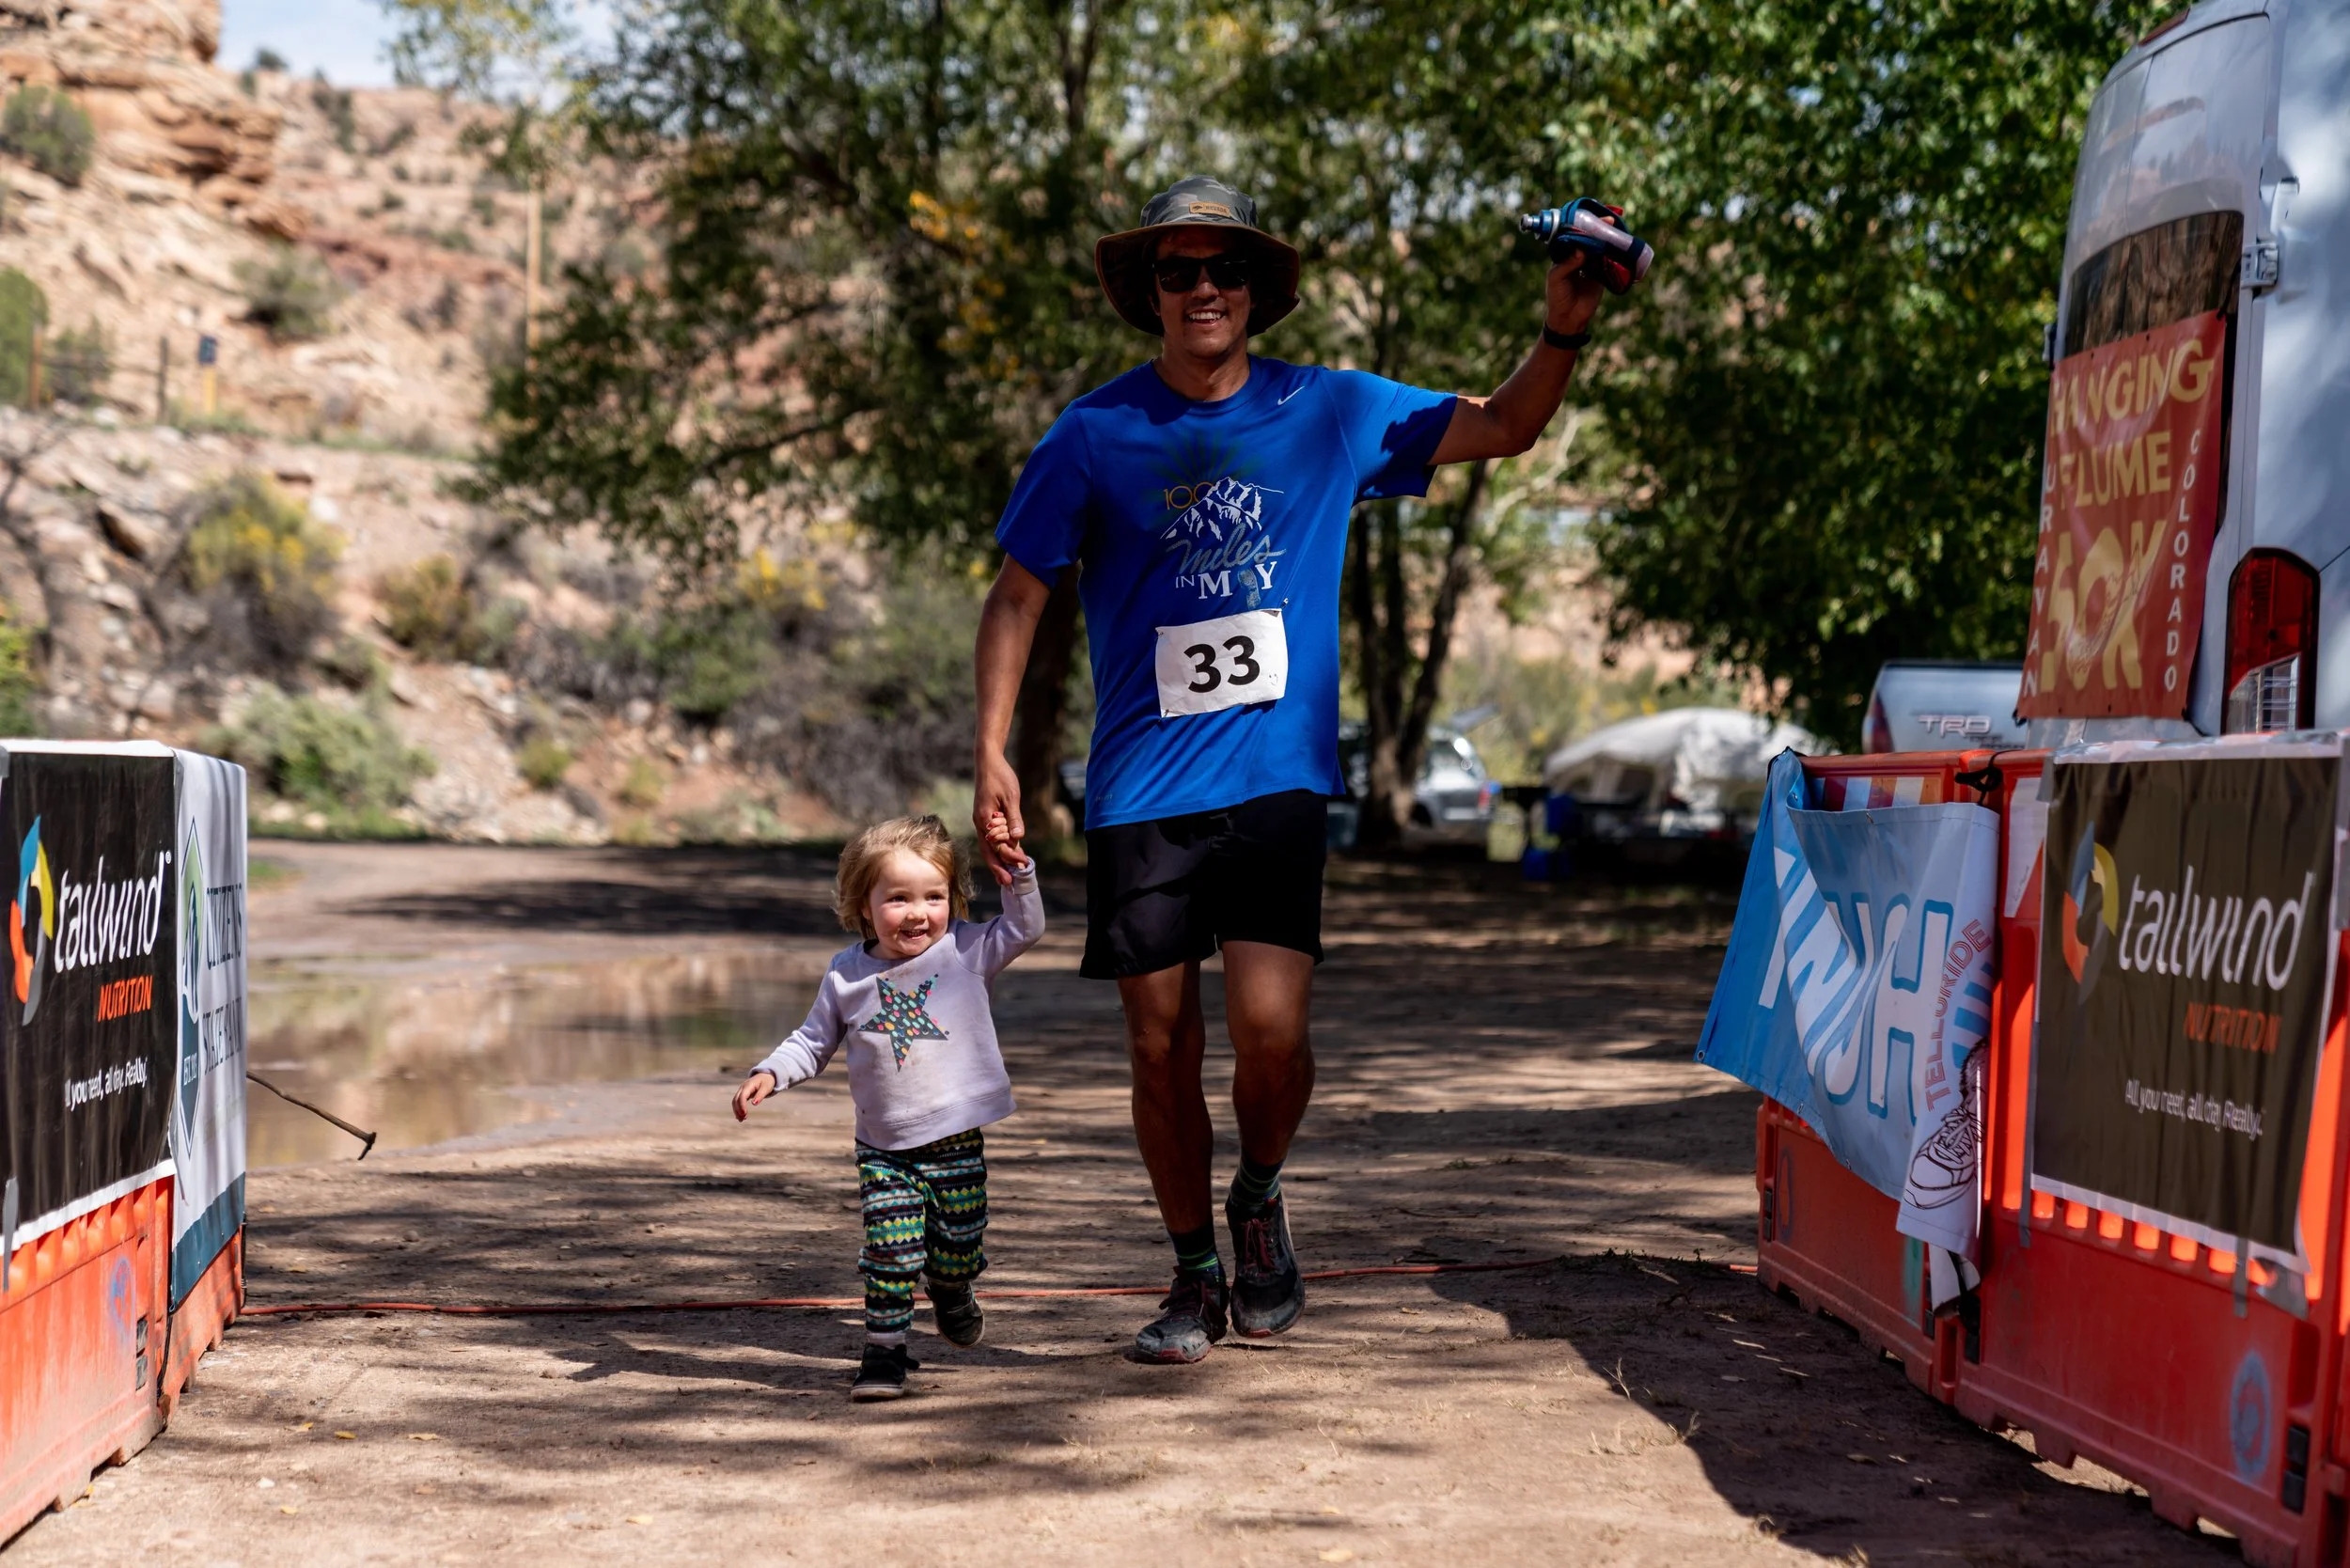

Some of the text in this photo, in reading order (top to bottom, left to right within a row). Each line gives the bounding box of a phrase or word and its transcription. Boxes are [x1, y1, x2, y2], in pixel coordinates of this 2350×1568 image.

[2050, 338, 2215, 438] HANGING
[1163, 481, 1214, 510] 100
[2059, 430, 2171, 510] FLUME
[1175, 574, 1195, 588] IN
[2023, 463, 2057, 698] URAVAN
[2164, 430, 2201, 692] COLORADO
[1183, 635, 1261, 694] 33
[1919, 714, 1991, 738] TRD
[2119, 865, 2315, 991] tailwind
[97, 975, 153, 1023] NUTRITION
[1925, 918, 1992, 1112] TELLURIDE
[2184, 1000, 2282, 1054] NUTRITION
[70, 1080, 88, 1112] you
[2138, 1087, 2161, 1114] you
[2186, 1092, 2204, 1121] all
